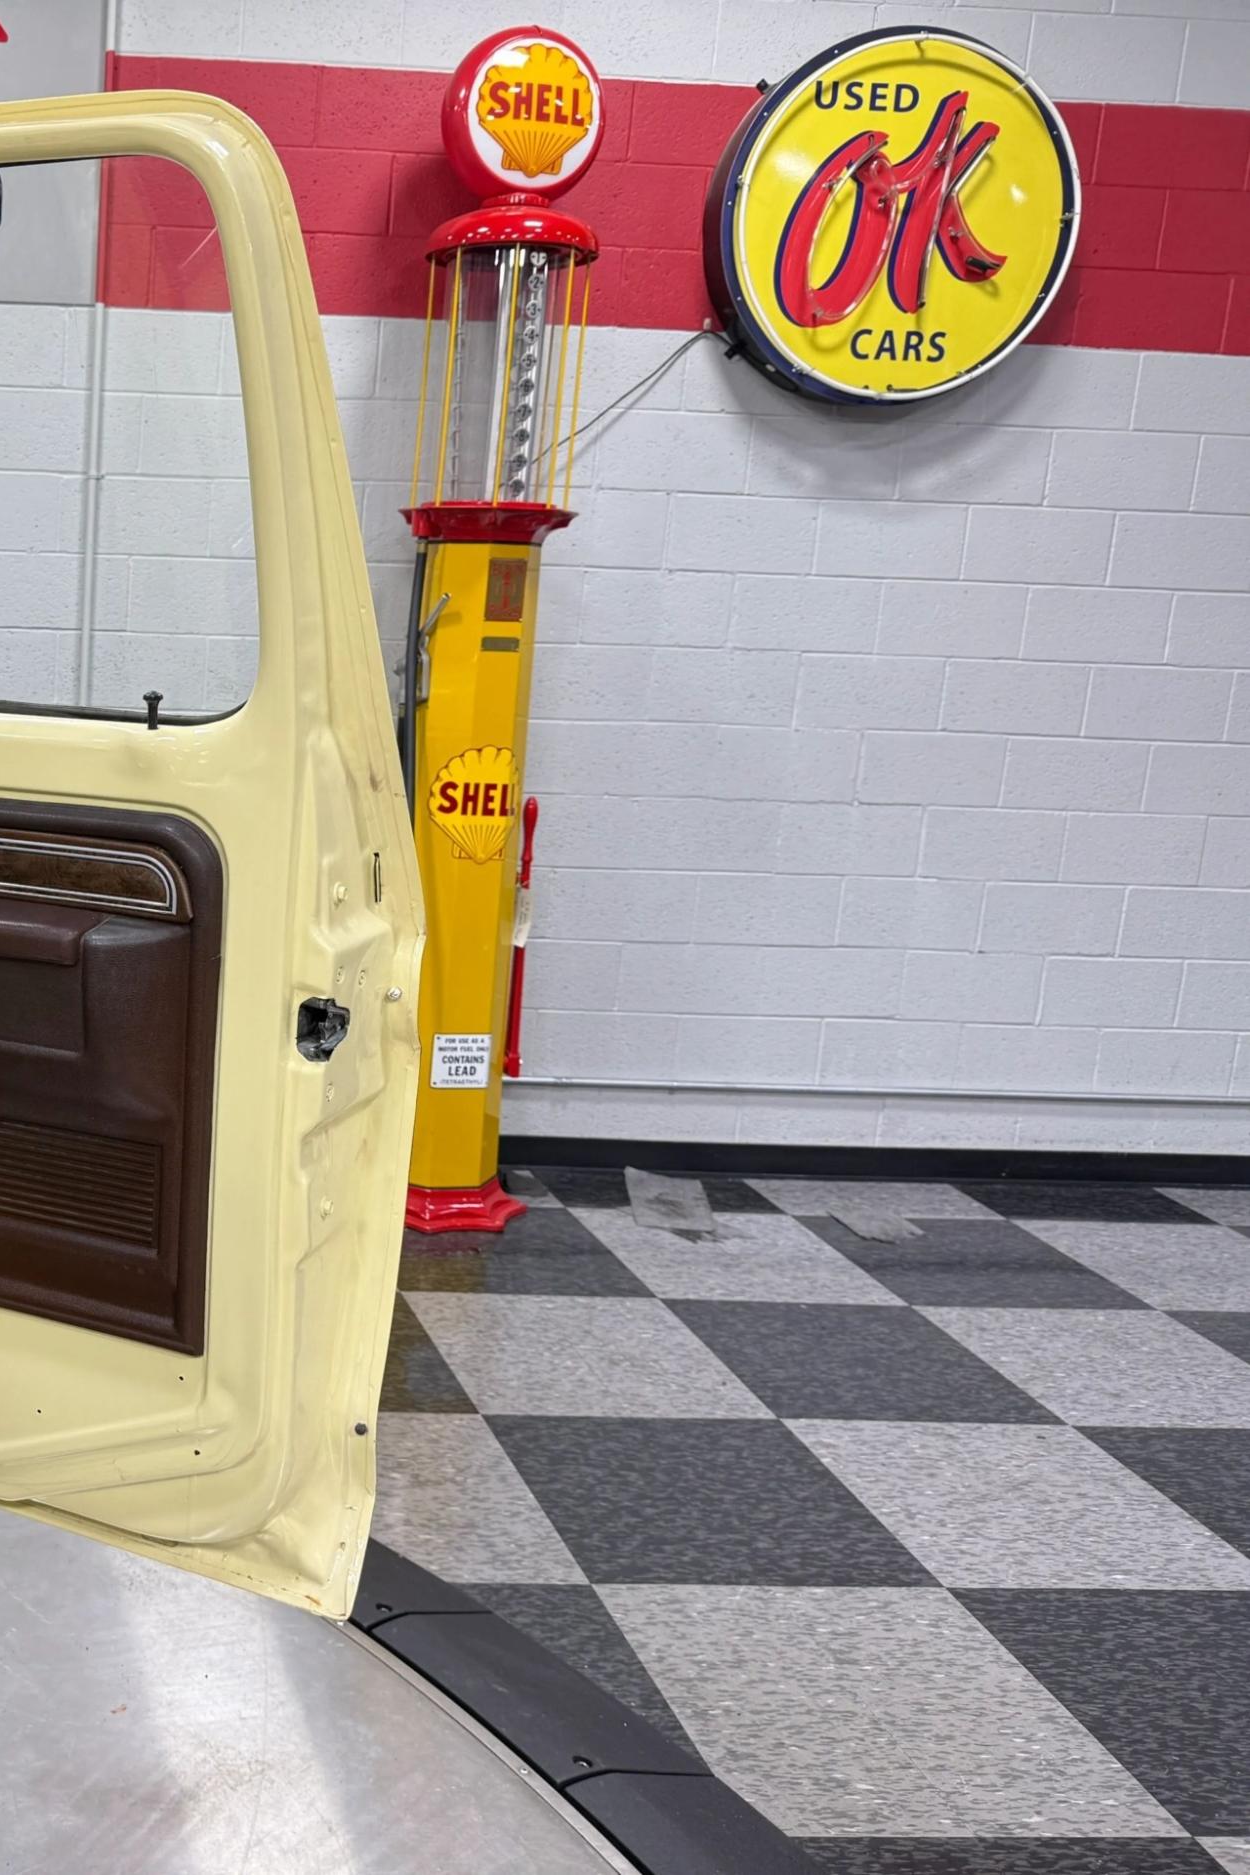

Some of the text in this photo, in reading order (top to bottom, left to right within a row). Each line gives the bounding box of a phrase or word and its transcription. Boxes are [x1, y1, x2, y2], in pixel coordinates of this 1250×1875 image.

[486, 80, 585, 127] SHELL
[814, 80, 920, 113] USED
[850, 328, 948, 363] CARS
[442, 1055, 485, 1064] CONTAINS
[448, 1066, 477, 1076] LEAD
